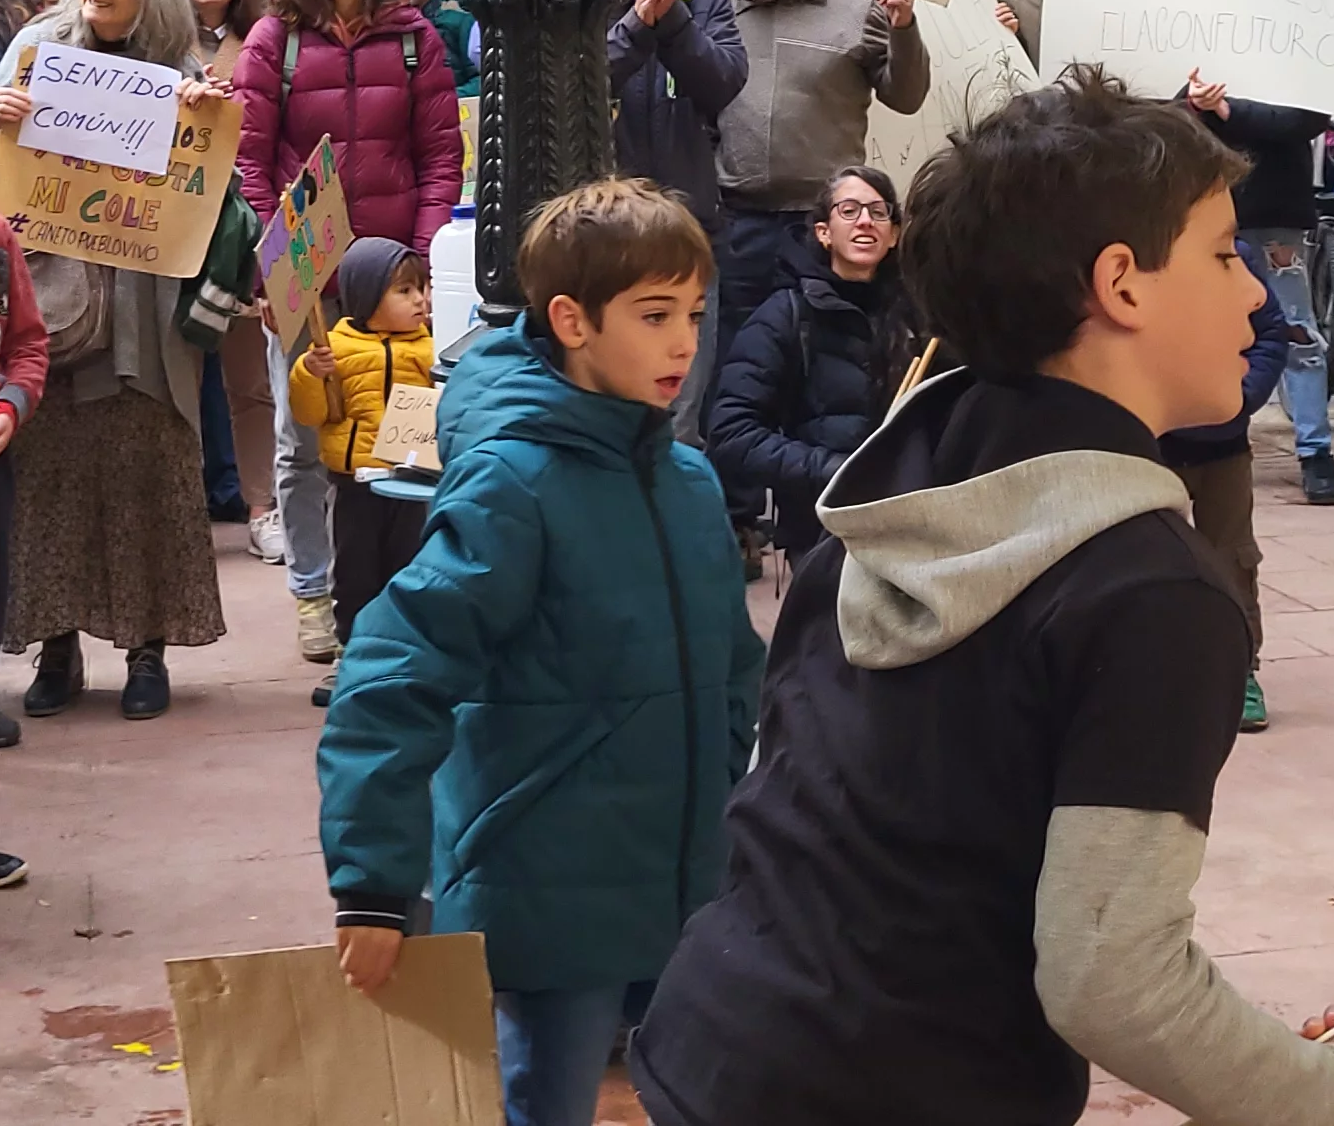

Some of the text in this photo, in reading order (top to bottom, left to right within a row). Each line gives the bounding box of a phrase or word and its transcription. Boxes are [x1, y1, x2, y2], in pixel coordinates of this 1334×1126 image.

[33, 106, 155, 157] COMÚN!!!
[27, 176, 162, 232] MI COLE
